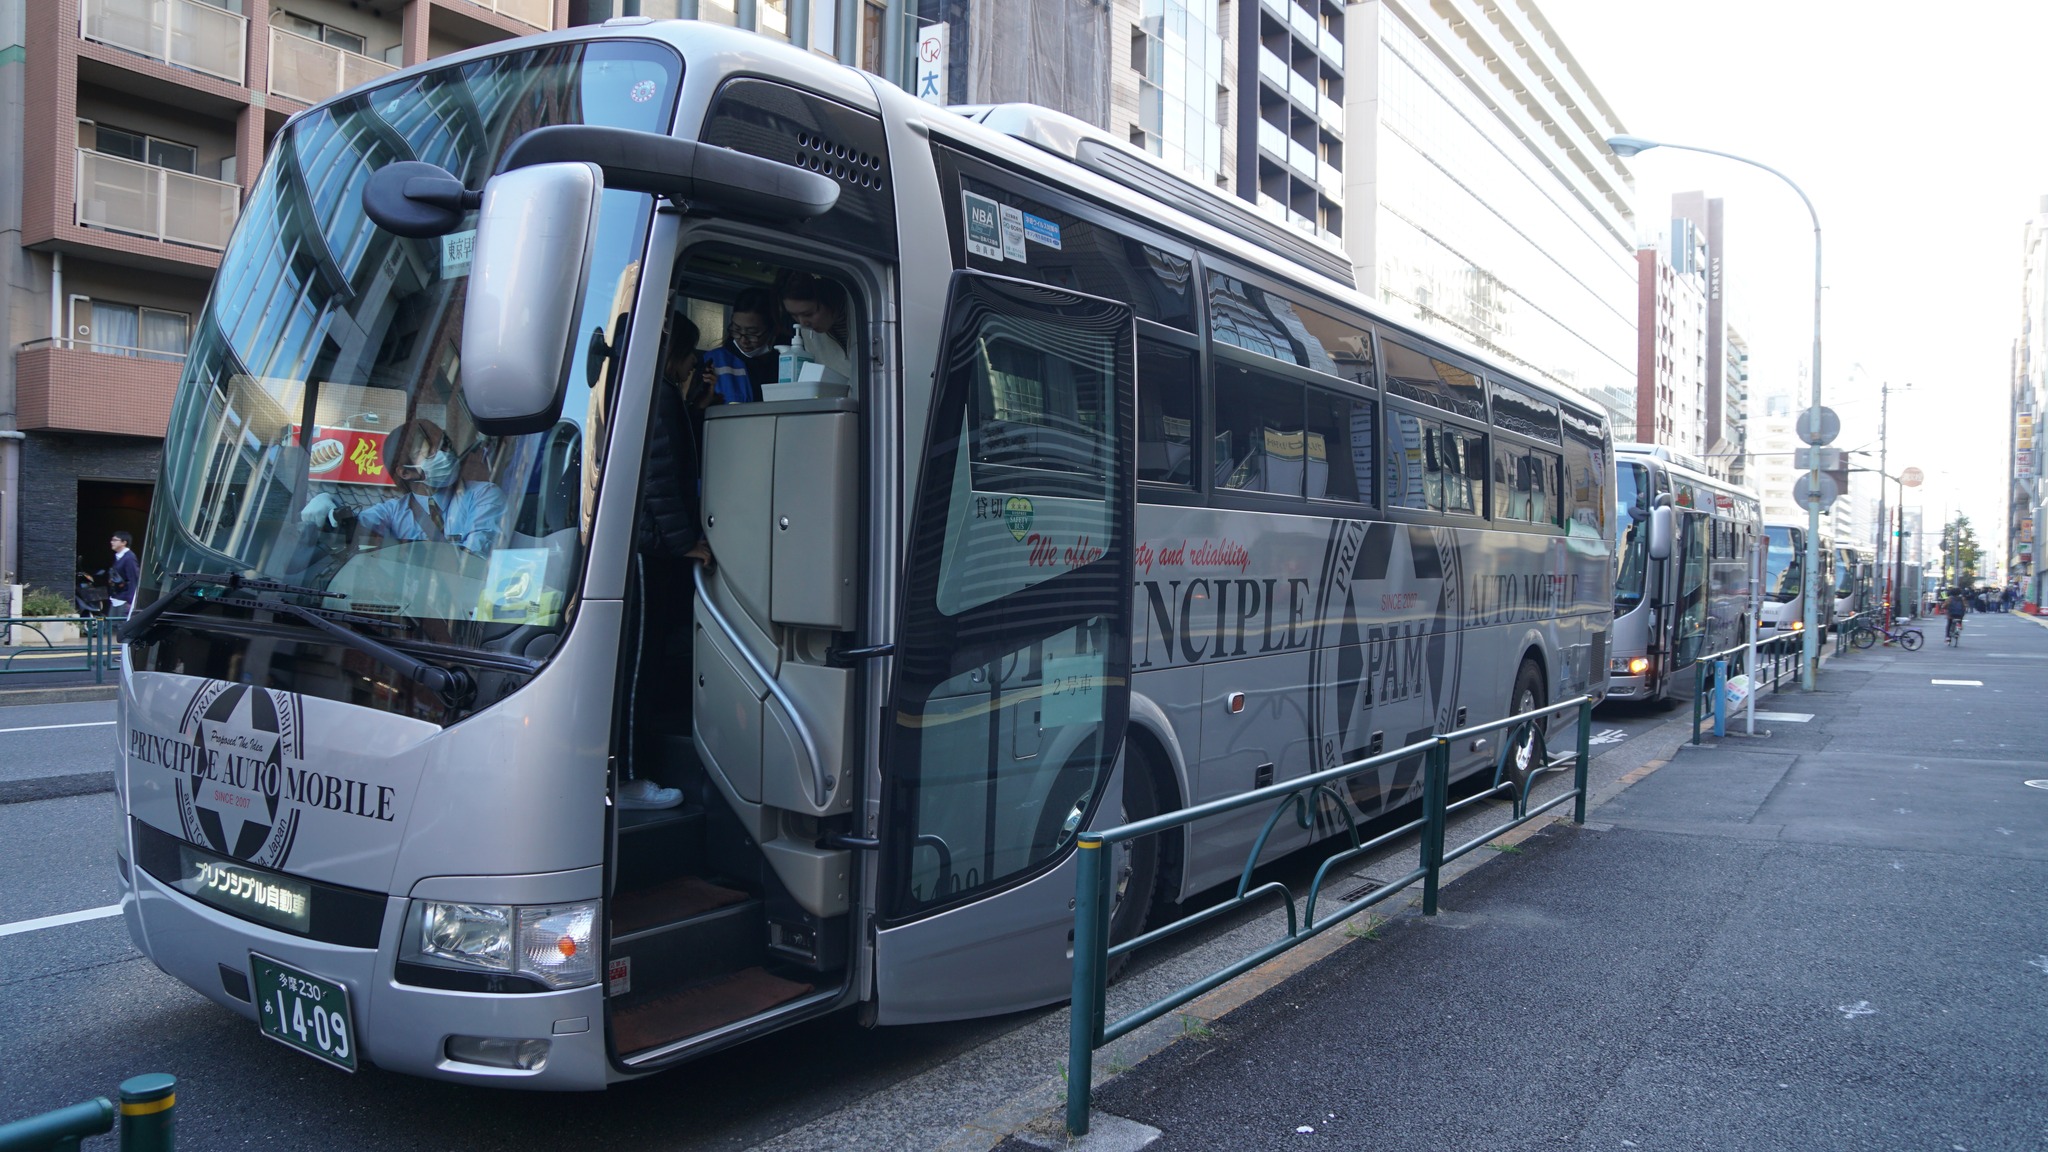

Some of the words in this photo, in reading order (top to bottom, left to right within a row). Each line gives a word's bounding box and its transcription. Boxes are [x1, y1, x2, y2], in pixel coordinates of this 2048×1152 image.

[921, 71, 938, 98] 太
[971, 206, 994, 228] NBA
[975, 496, 1003, 520] 貸切
[1010, 516, 1028, 524] SAFETY
[1027, 533, 1057, 568] We
[1158, 538, 1187, 566] and
[1381, 593, 1402, 612] SINCE
[1403, 592, 1418, 609] 2007
[1465, 573, 1518, 627] AUTO
[1521, 573, 1580, 621] MOBILE
[1363, 619, 1428, 711] PAM
[1052, 673, 1092, 696] 2号車
[210, 730, 238, 747] Proposed
[239, 736, 249, 749] The
[250, 739, 264, 752] Idea
[131, 728, 218, 781] PRINCIPLE
[222, 753, 280, 797] AUTO
[284, 766, 396, 822] MOBILE
[214, 790, 234, 806] SINCE
[235, 794, 251, 809] 2007
[269, 818, 287, 858] Japan
[195, 862, 306, 918] プリンシプル自動車
[277, 989, 349, 1059] 14-09
